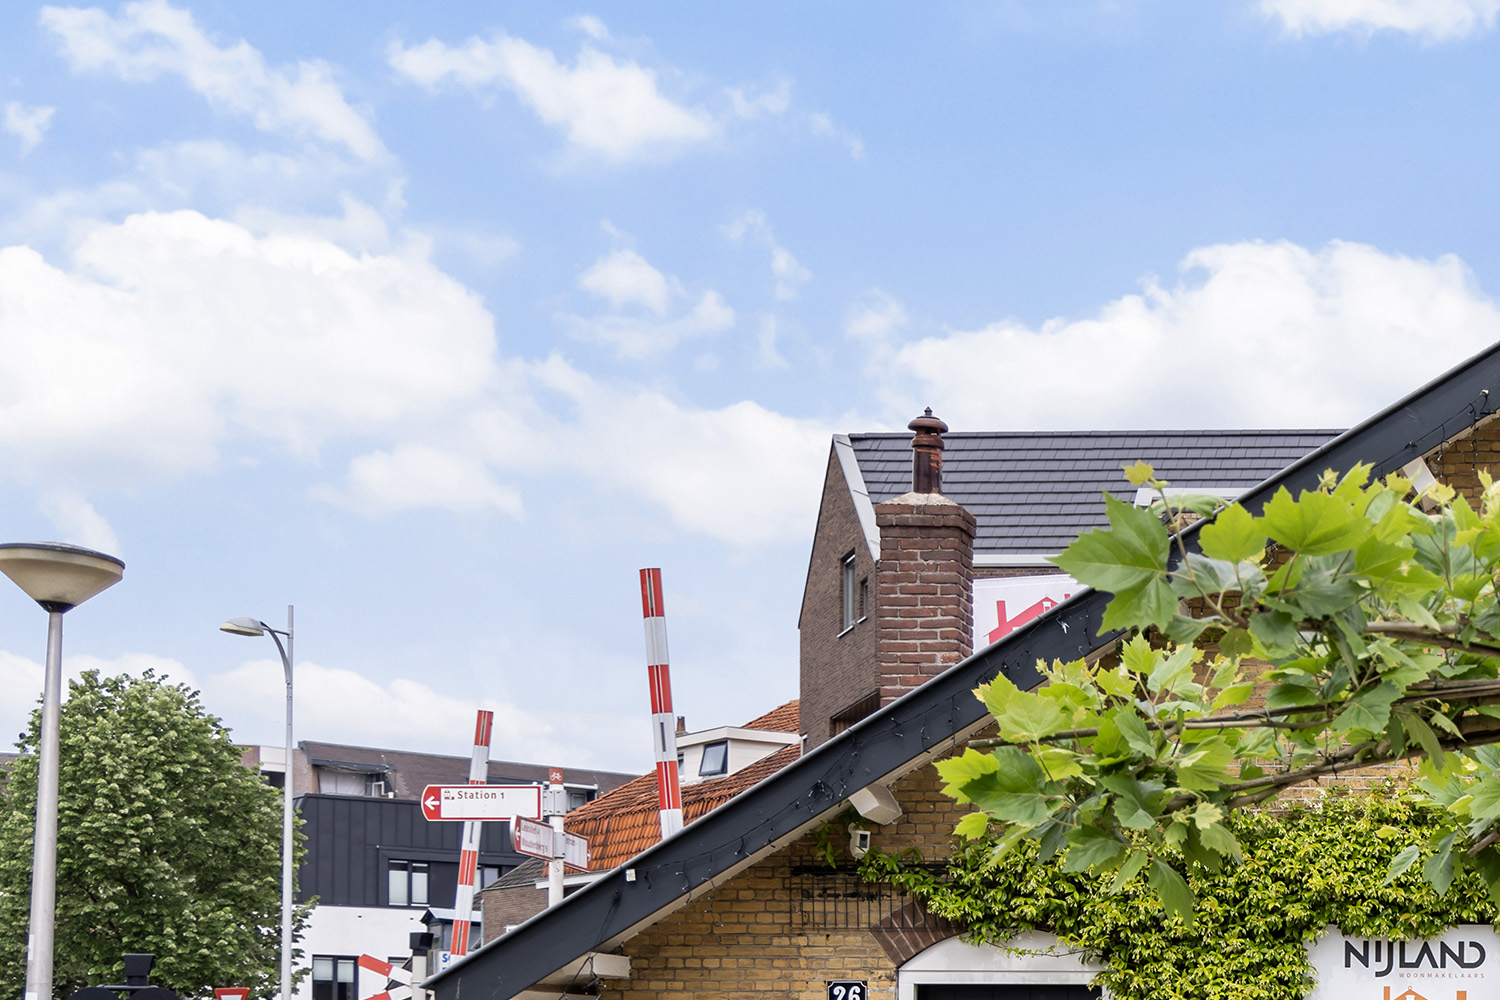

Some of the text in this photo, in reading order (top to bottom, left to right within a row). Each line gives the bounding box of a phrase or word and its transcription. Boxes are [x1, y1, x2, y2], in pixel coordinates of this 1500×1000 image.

[457, 790, 505, 800] Station 1
[1344, 940, 1487, 978] NIJLAND
